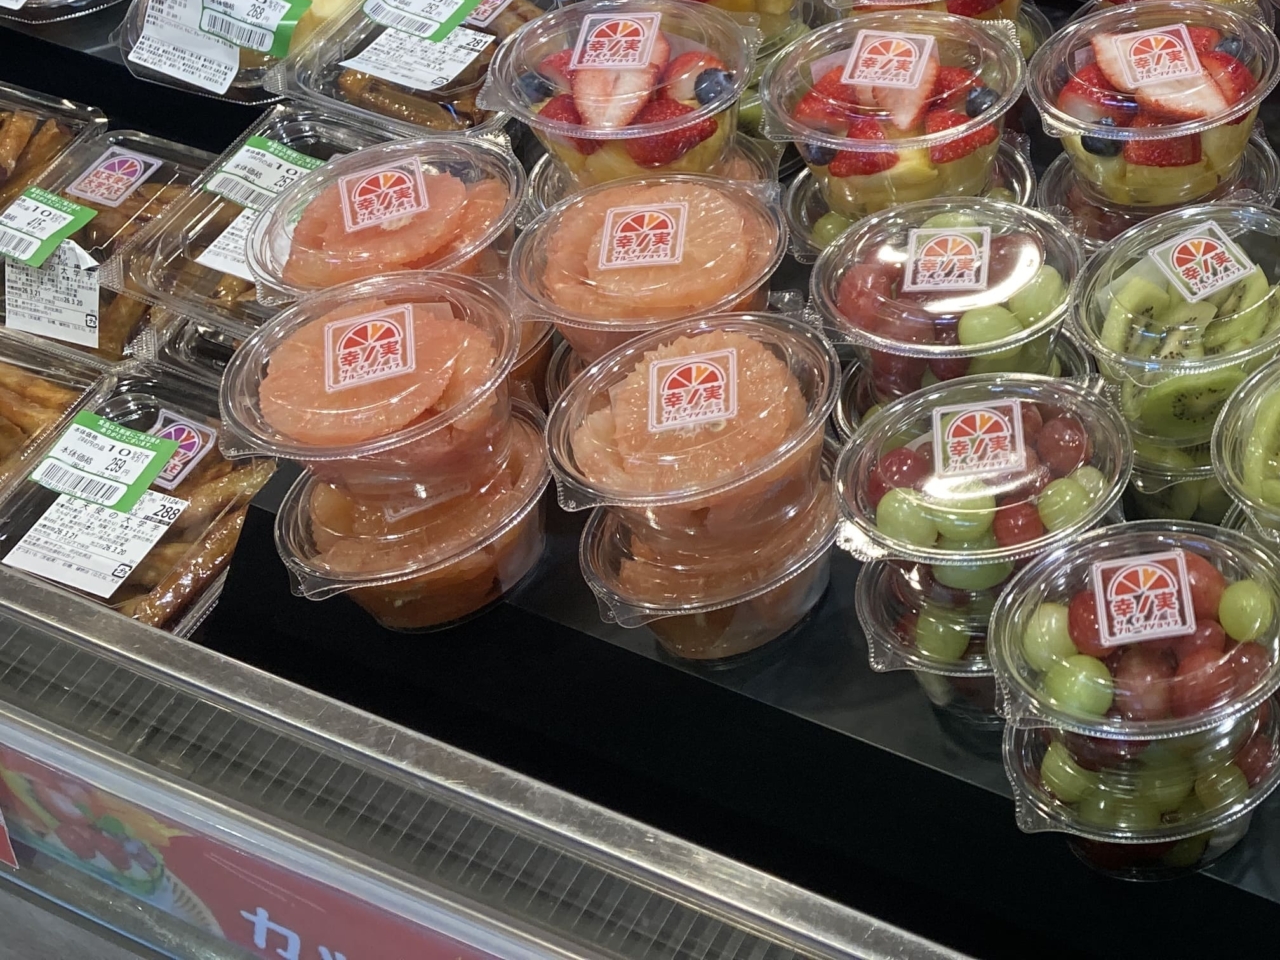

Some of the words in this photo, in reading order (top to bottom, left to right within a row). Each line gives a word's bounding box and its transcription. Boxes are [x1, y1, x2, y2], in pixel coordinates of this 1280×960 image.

[467, 38, 488, 49] 281
[74, 427, 98, 440] 本体価格
[948, 433, 1009, 458] 幸ノ実
[61, 446, 93, 465] 本体価格
[153, 504, 181, 521] 288
[1111, 590, 1176, 619] 幸ノ実
